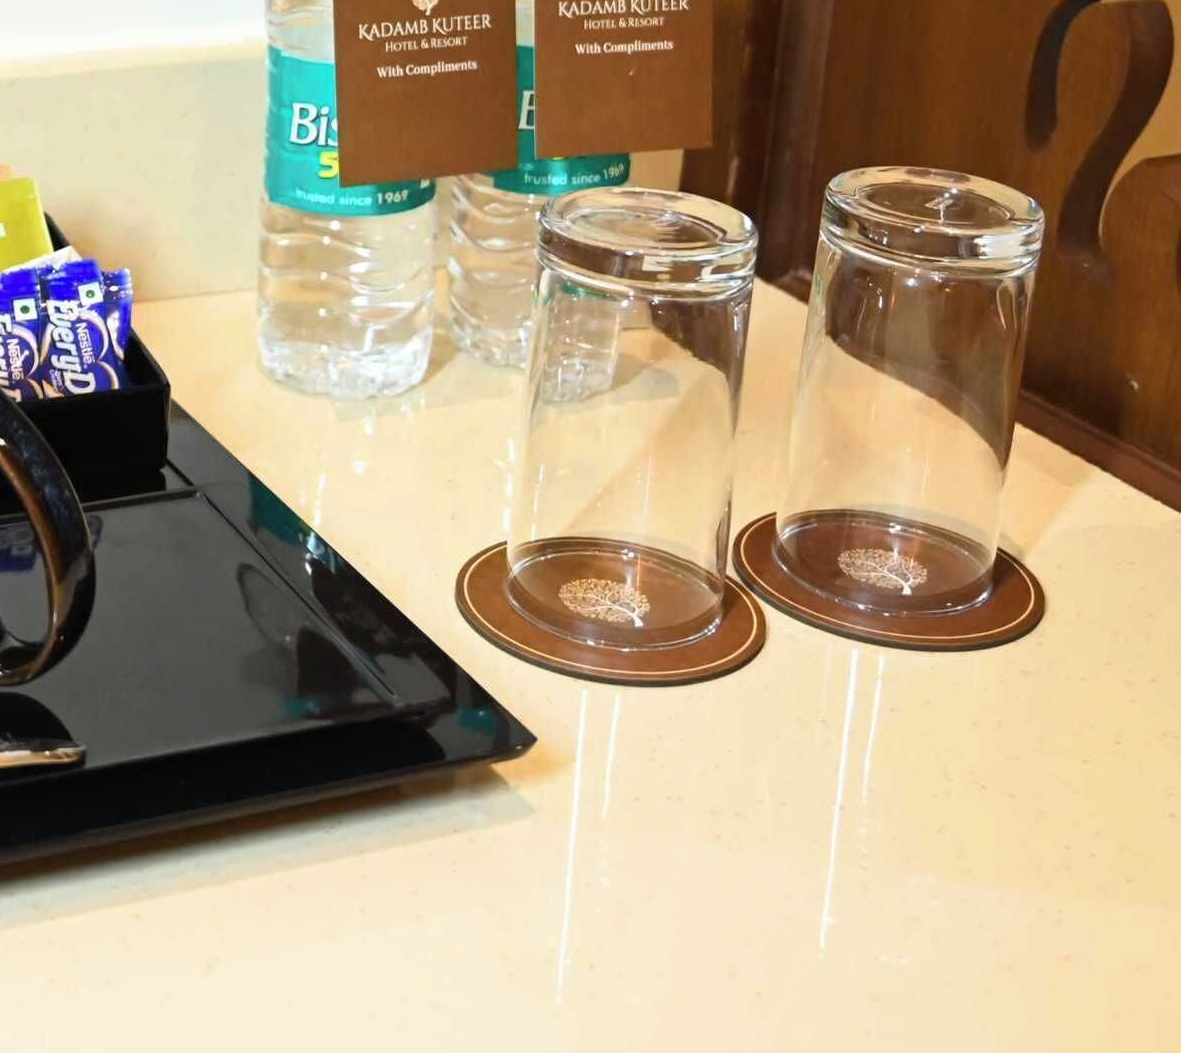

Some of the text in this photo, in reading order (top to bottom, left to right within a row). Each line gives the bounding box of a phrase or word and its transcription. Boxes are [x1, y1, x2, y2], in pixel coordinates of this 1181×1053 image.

[358, 13, 492, 41] KADAMB KUTEER
[584, 16, 665, 30] HOTEL & RESORT
[385, 36, 468, 52] HOTEL & RESORT
[575, 39, 674, 54] With Compliments
[377, 60, 478, 78] With Compliments
[524, 163, 625, 185] trusted since 1969
[338, 193, 372, 206] since
[376, 189, 409, 204] 1969
